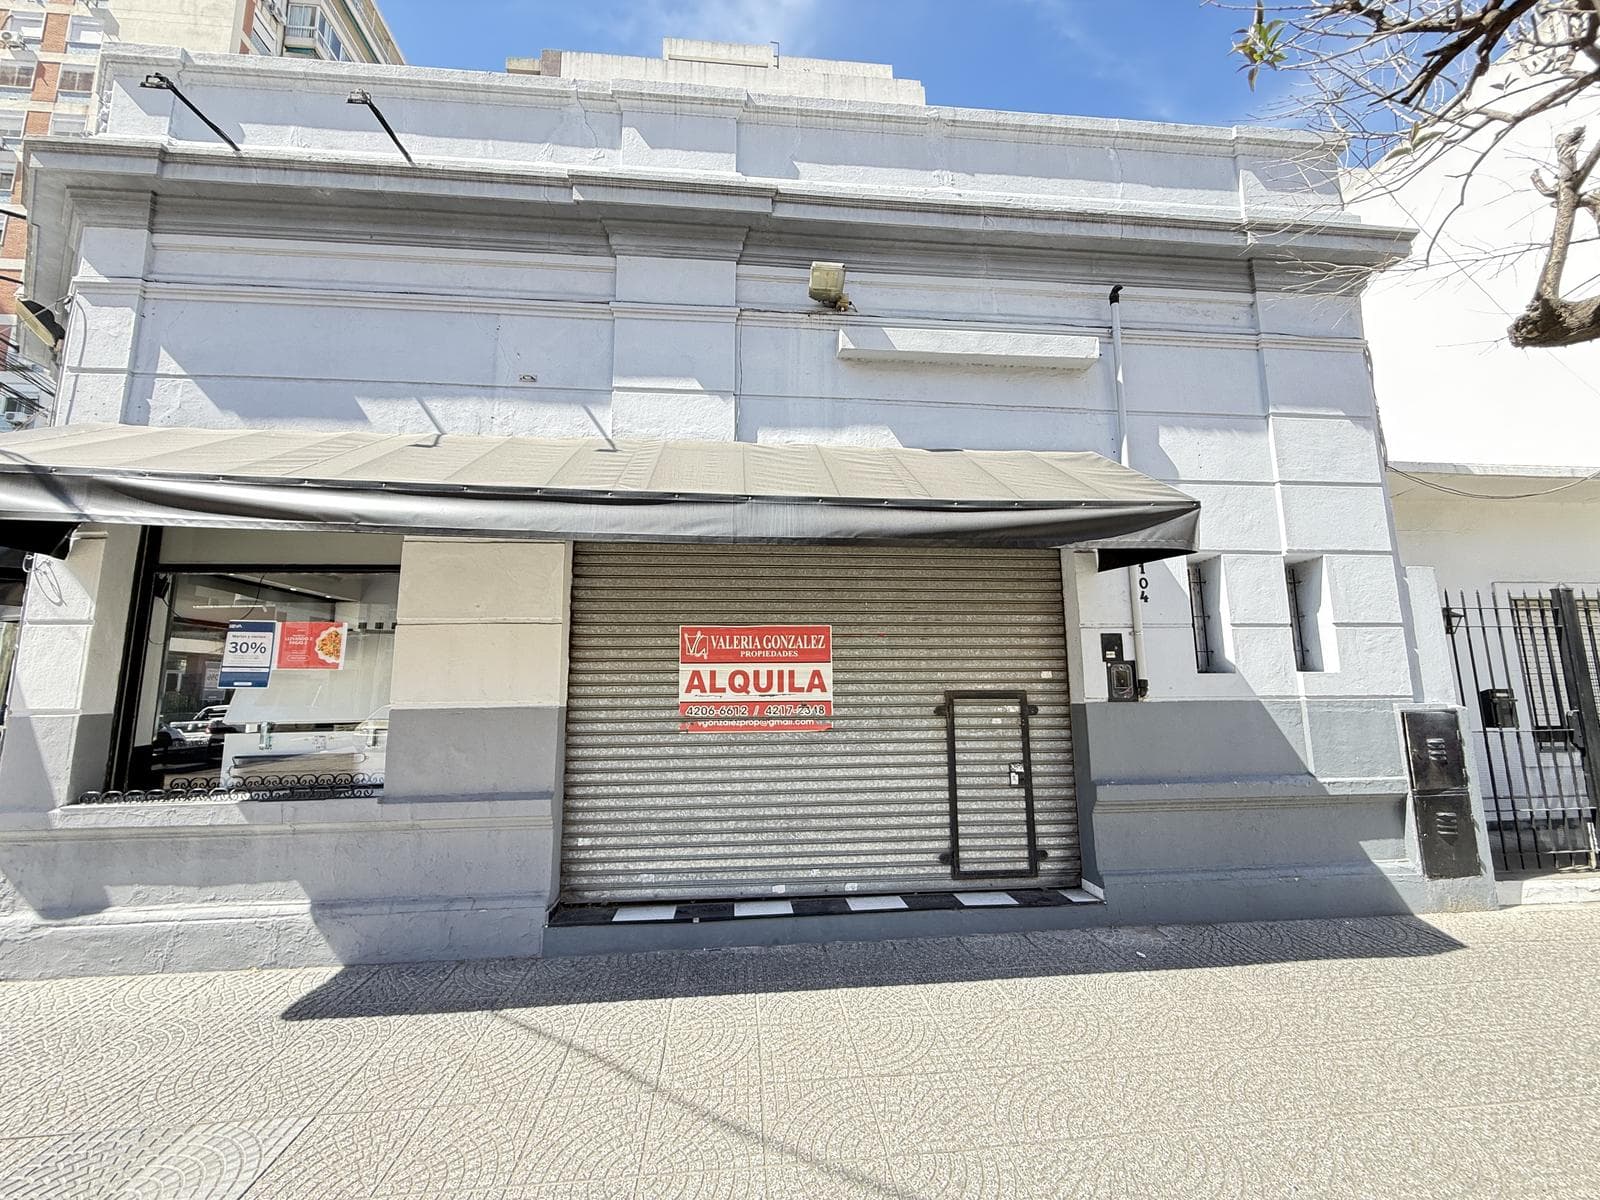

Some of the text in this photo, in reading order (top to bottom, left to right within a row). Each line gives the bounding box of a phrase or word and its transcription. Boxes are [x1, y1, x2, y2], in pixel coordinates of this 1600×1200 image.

[228, 641, 267, 654] 30%
[710, 635, 826, 650] VALERIA GONZALEZ
[740, 650, 799, 658] PROPIEDADES
[684, 669, 828, 695] ALQUILA
[686, 705, 748, 716] 4206-6612
